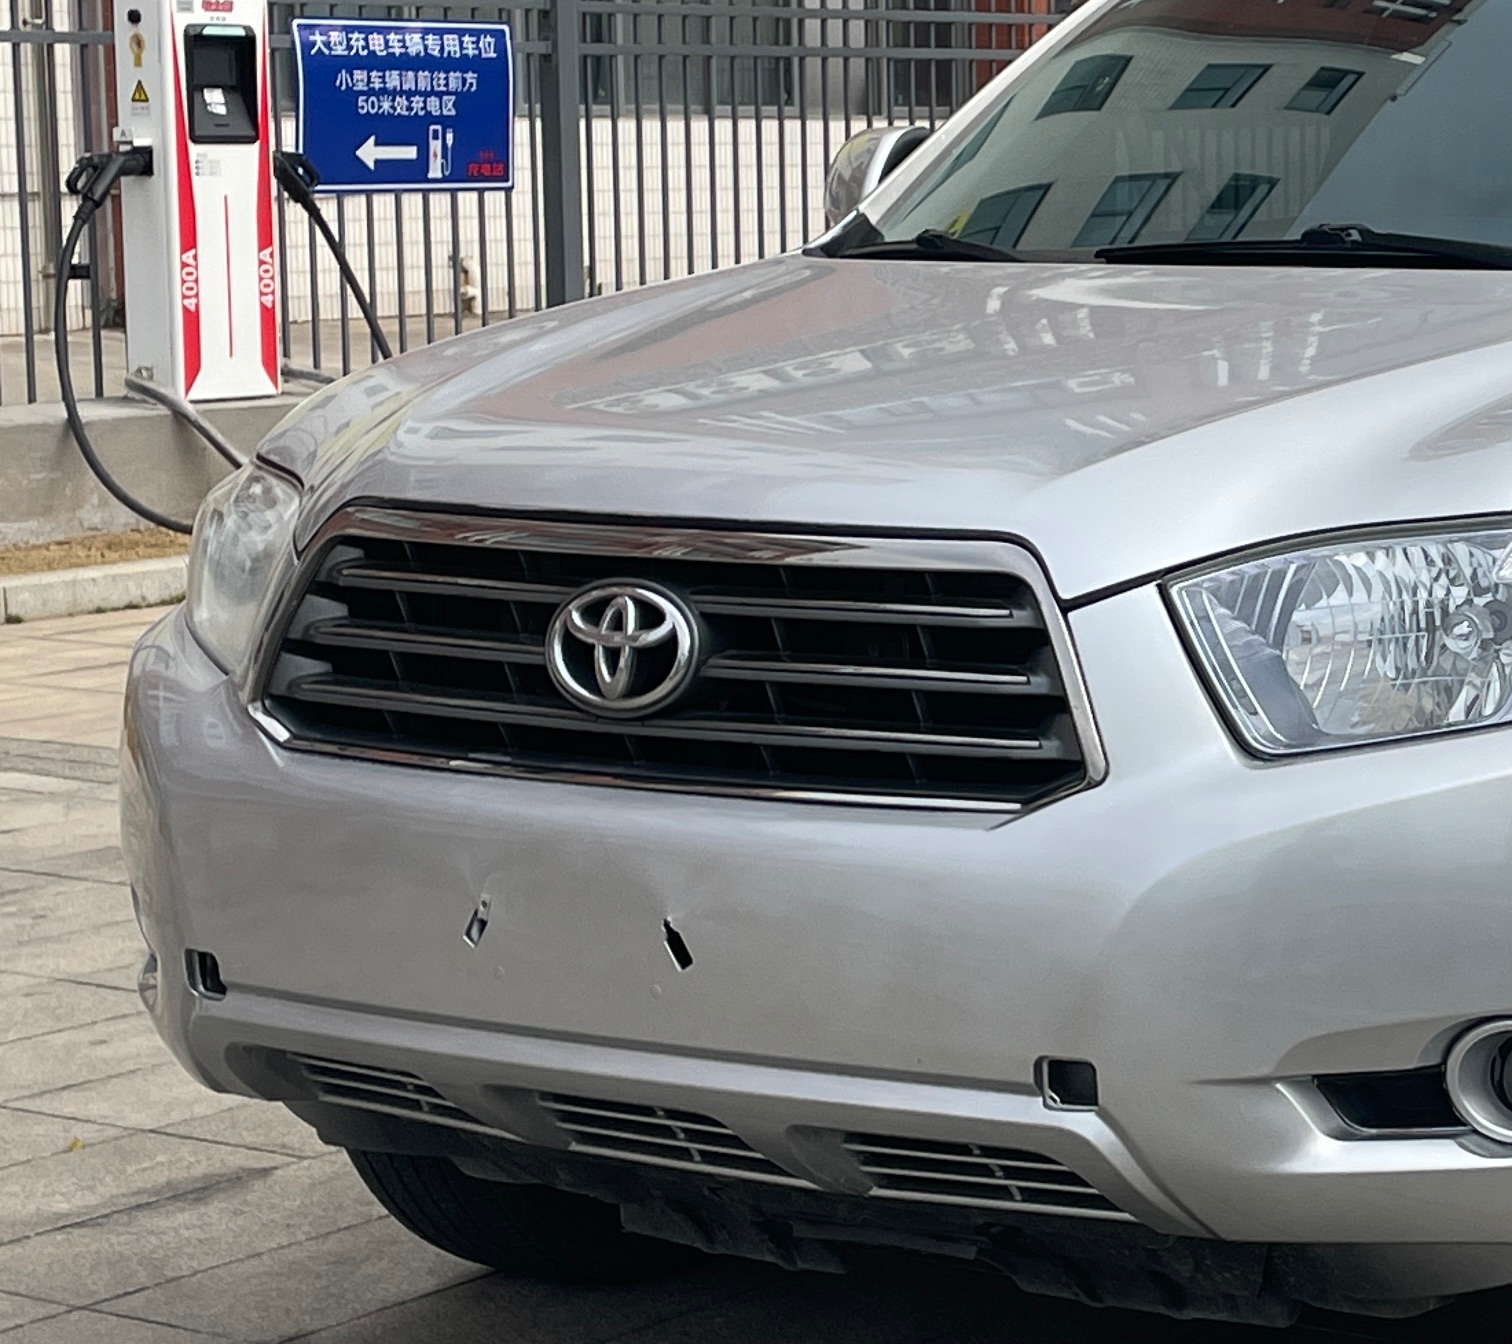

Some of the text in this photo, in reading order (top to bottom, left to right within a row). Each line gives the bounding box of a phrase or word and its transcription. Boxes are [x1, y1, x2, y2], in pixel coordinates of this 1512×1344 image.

[309, 30, 497, 58] 大型充电车辆专用车位
[335, 69, 478, 92] 小型车辆请前往前方
[357, 95, 457, 116] 50米处充电区
[181, 248, 197, 312] 400A
[259, 246, 274, 309] 400A
